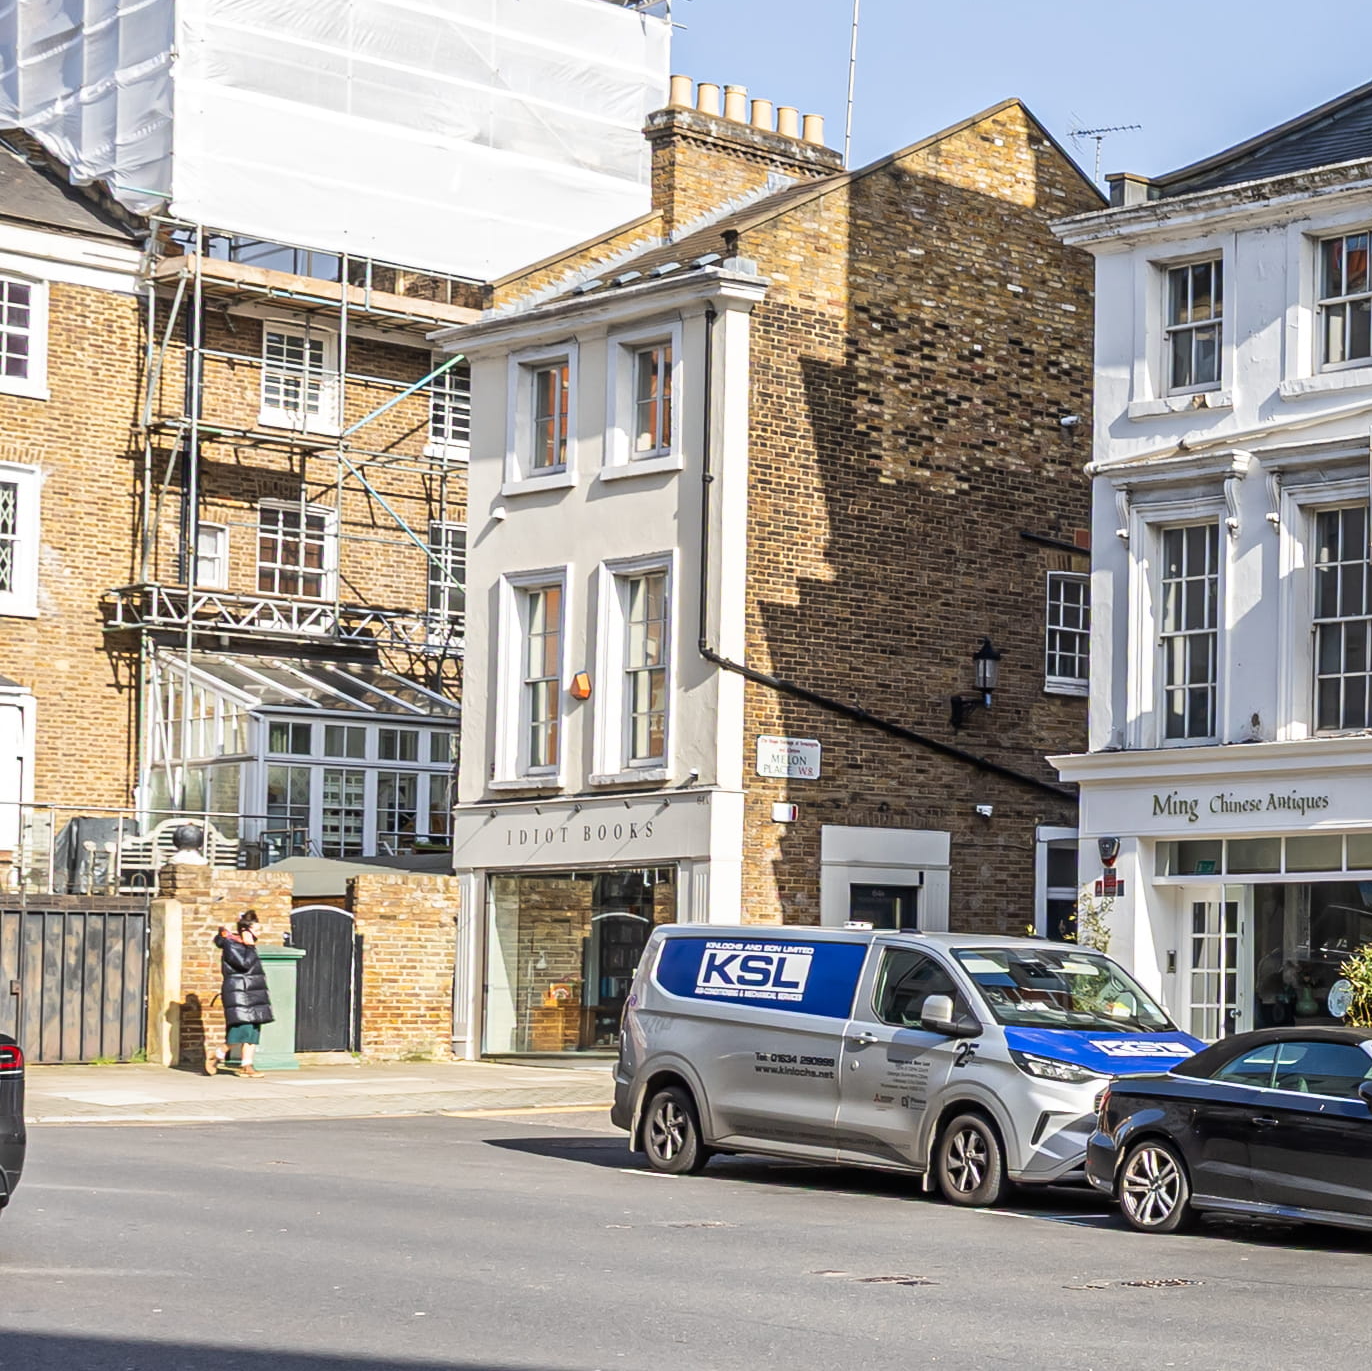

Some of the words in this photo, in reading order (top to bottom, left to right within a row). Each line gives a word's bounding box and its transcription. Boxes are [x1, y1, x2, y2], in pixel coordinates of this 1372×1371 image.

[771, 754, 807, 766] MELON
[1153, 791, 1199, 822] Ming
[1210, 793, 1262, 814] Chinese
[1266, 789, 1329, 816] Antiques
[507, 827, 568, 845] IDIOT
[584, 821, 653, 842] BOOKS
[745, 943, 762, 951] AND
[783, 946, 814, 954] LIMITED
[702, 953, 800, 989] KSL
[1101, 1043, 1190, 1054] KSL
